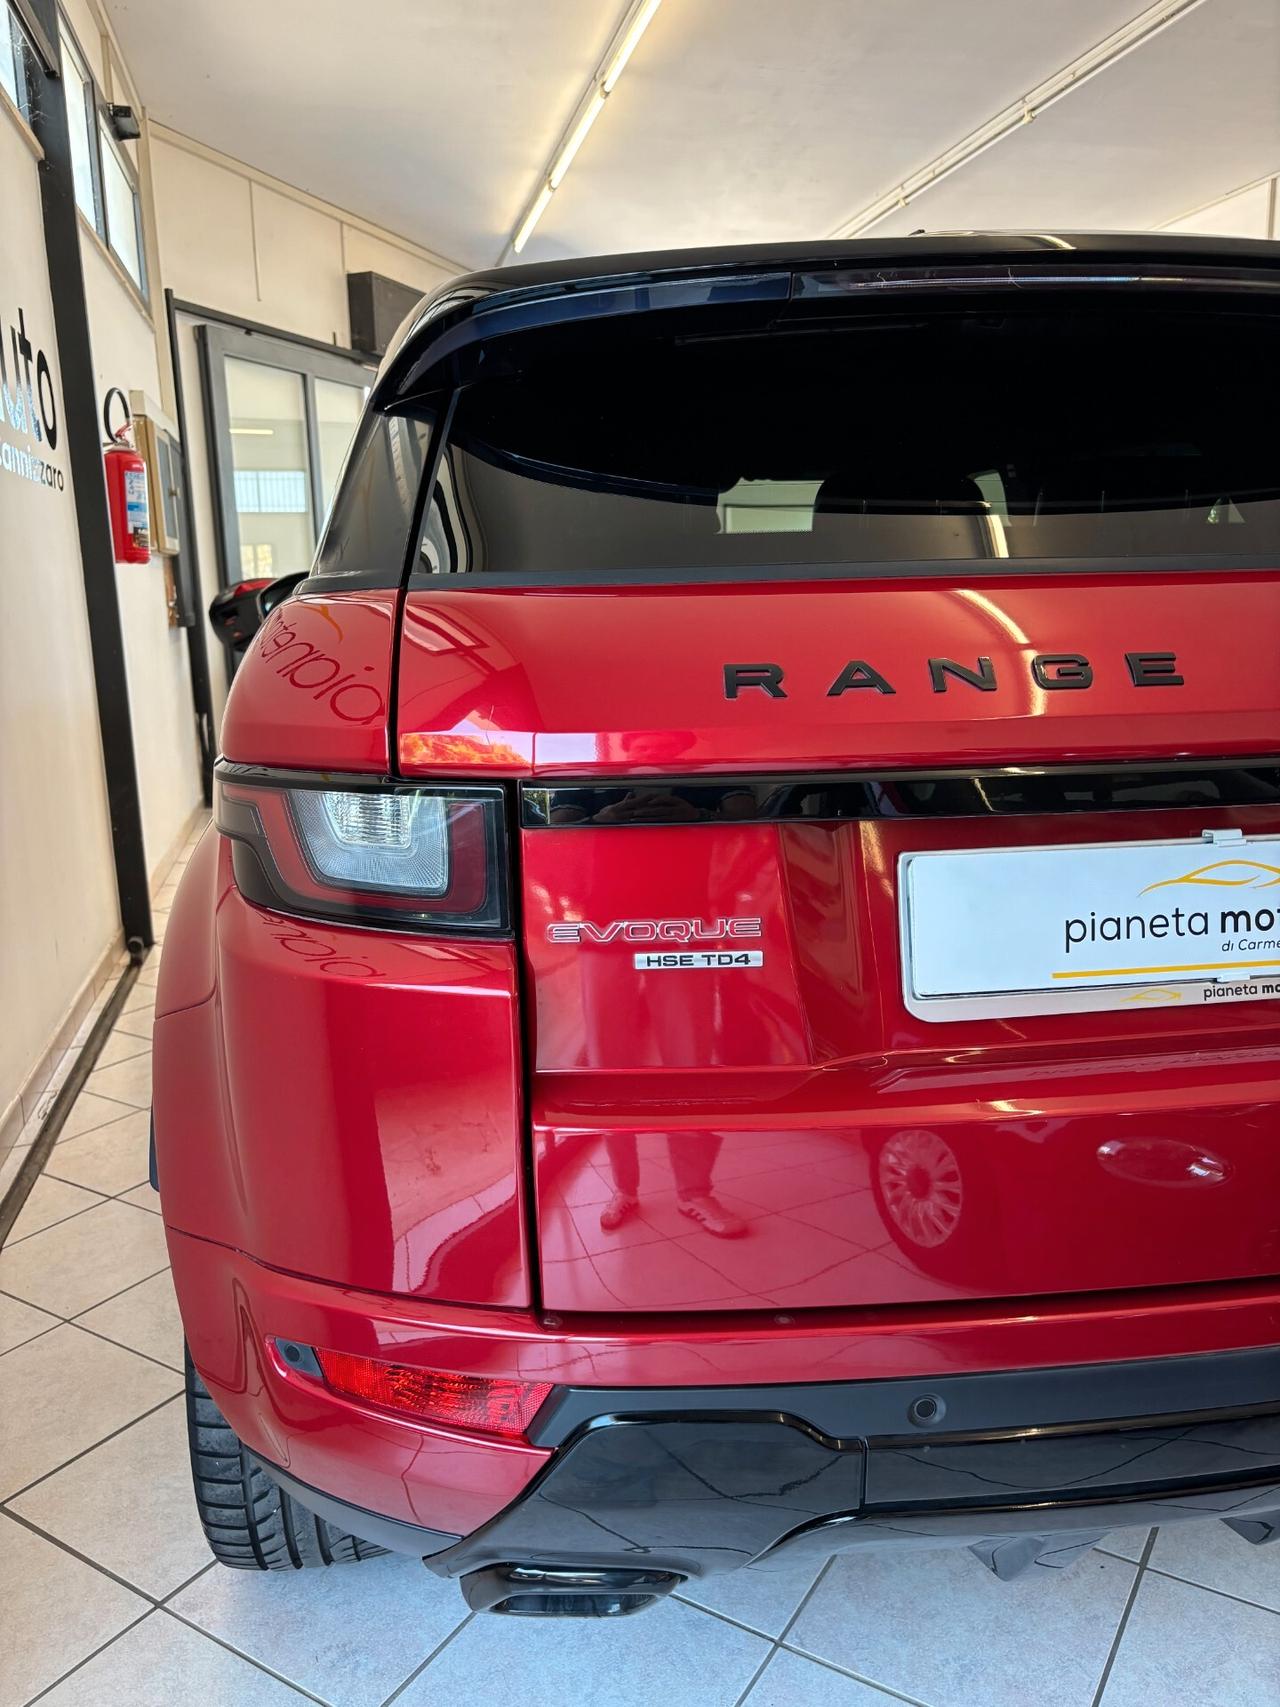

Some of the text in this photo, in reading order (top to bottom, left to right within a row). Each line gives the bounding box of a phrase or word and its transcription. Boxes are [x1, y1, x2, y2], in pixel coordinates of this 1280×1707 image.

[723, 652, 1185, 699] RANGE
[547, 917, 762, 943] EVOQUE
[1065, 906, 1280, 953] pianeta mo
[1221, 940, 1234, 952] di
[646, 953, 751, 967] HSE TD4
[1203, 983, 1258, 1001] pianeta
